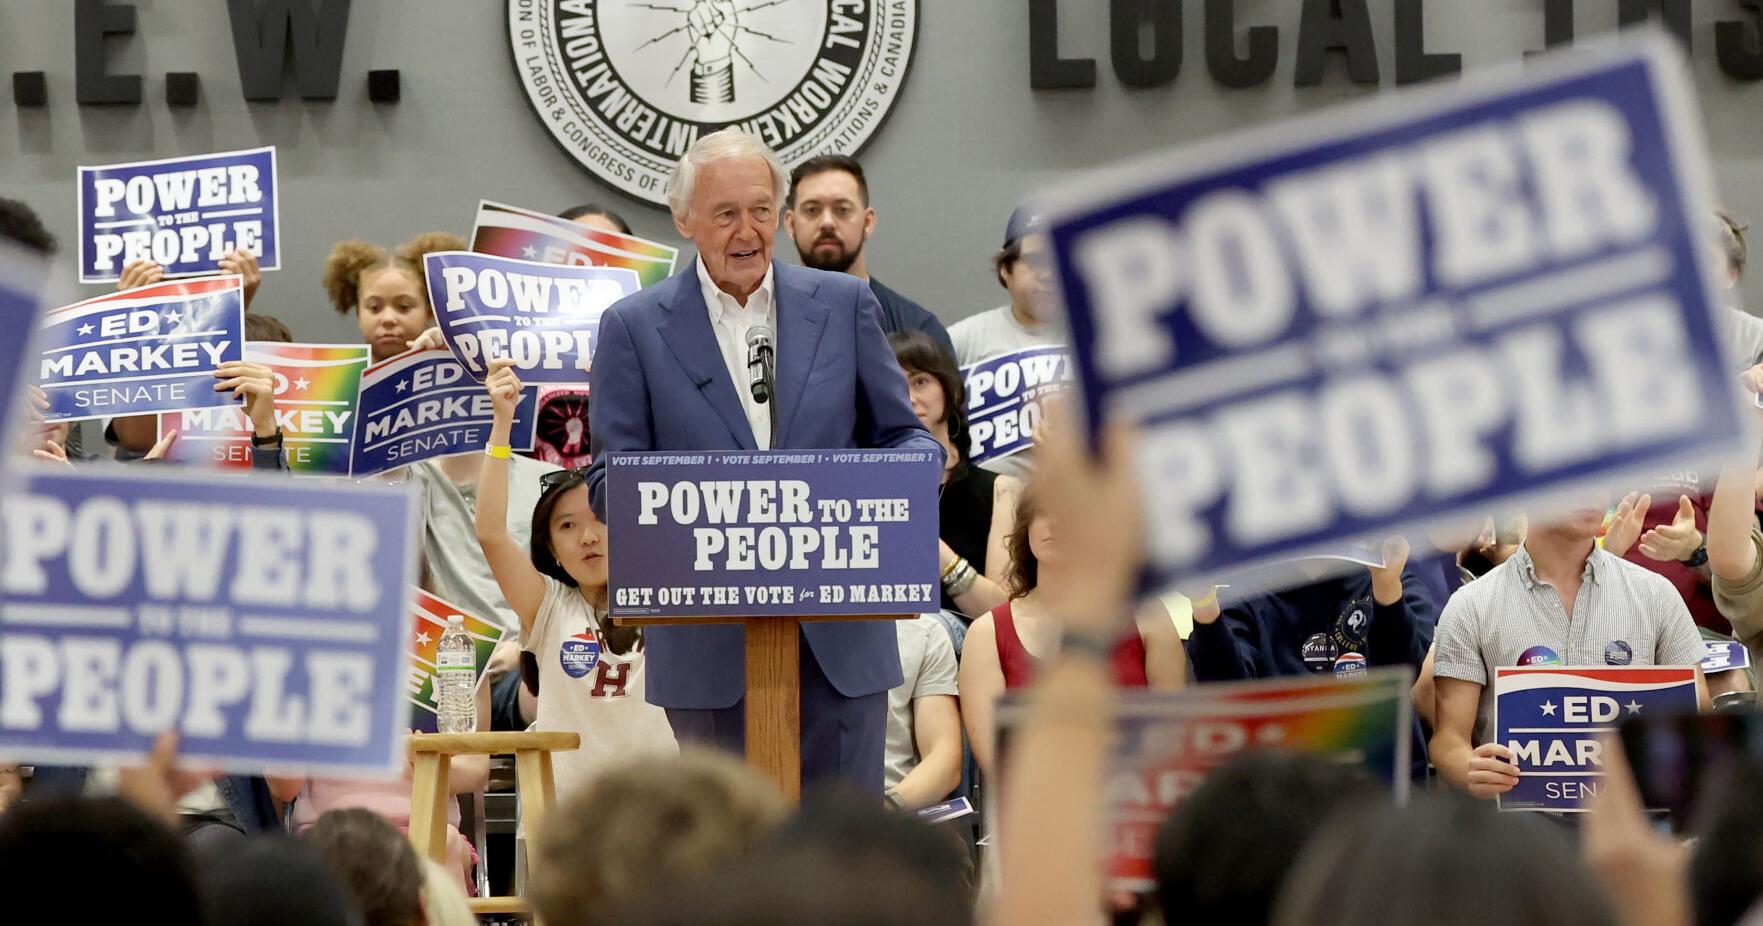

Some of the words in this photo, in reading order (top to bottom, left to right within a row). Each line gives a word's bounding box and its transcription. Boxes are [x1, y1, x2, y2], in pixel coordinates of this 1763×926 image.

[520, 29, 537, 49] OF
[526, 56, 560, 108] LABOR
[874, 83, 889, 95] &
[552, 107, 565, 123] &
[562, 121, 636, 182] CONGRESS
[94, 165, 262, 217] POWER
[638, 174, 660, 192] OF
[157, 214, 174, 226] TO
[174, 211, 200, 225] THE
[94, 220, 262, 270] PEOPLE
[1074, 94, 1662, 382] POWER
[543, 245, 593, 267] ED
[100, 309, 160, 337] ED
[514, 315, 531, 327] TO
[40, 340, 231, 380] MARKEY
[412, 362, 464, 392] ED
[74, 383, 186, 407] SENATE
[1021, 388, 1036, 402] TO
[182, 409, 352, 434] MAKEY
[1132, 288, 1708, 575] PEOPLE
[213, 445, 311, 463] SETE
[387, 428, 480, 461] SENATE
[612, 456, 640, 466] VOTE
[641, 455, 706, 466] SEPTEMBER
[706, 455, 713, 465] 1
[722, 455, 750, 465] VOTE
[752, 454, 816, 465] SEPTEMBER
[817, 454, 823, 464] 1
[832, 453, 861, 463] VOTE
[862, 452, 926, 463] SEPTEMBER
[927, 452, 933, 462] 1
[638, 480, 813, 525] POWER
[818, 499, 851, 523] TO
[857, 499, 909, 523] THE
[0, 494, 382, 612] POWER
[694, 526, 879, 571] PEOPLE
[616, 587, 653, 607] GET
[658, 586, 696, 606] OUT
[700, 586, 739, 605] THE
[744, 585, 794, 605] VOTE
[800, 587, 815, 602] for
[819, 585, 845, 604] ED
[850, 584, 933, 603] MARKEY
[562, 654, 596, 663] MARKEY
[573, 644, 585, 652] ED
[1530, 655, 1544, 665] ED
[591, 660, 631, 697] H
[1345, 663, 1357, 671] ED
[0, 635, 376, 749] PEOPLE
[1563, 696, 1621, 724] ED
